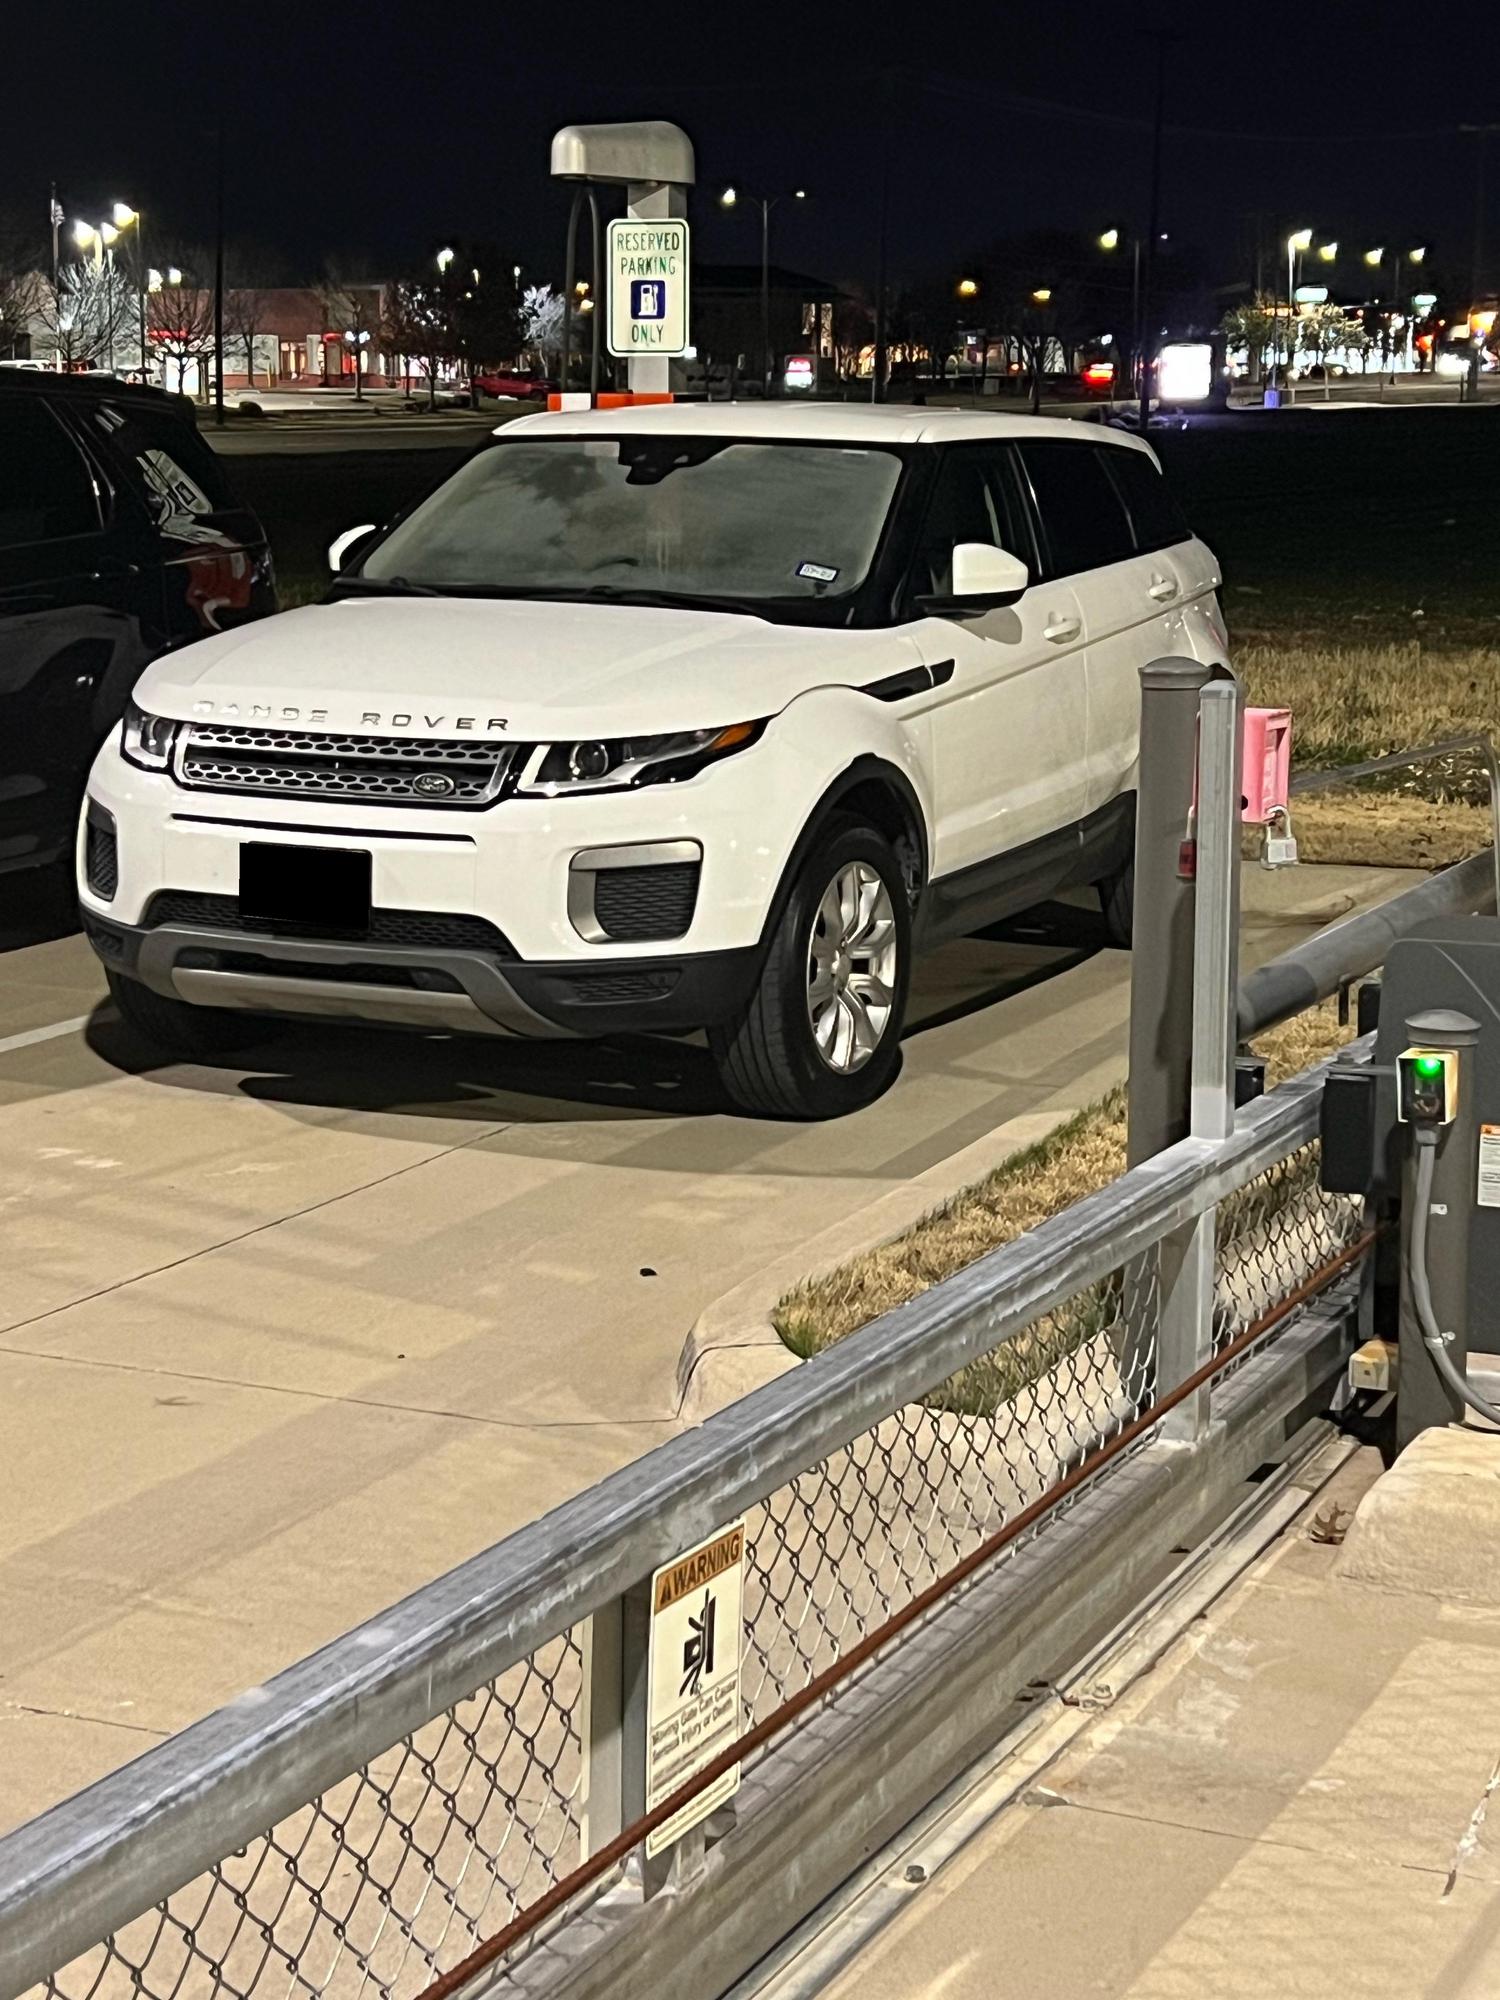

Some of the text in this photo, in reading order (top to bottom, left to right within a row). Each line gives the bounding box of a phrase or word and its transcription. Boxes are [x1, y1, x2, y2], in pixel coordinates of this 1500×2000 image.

[616, 232, 680, 251] RESERVED
[620, 256, 676, 275] PARKING
[631, 324, 664, 343] ONLY
[360, 712, 508, 731] ROVER
[673, 1533, 740, 1596] WARNING
